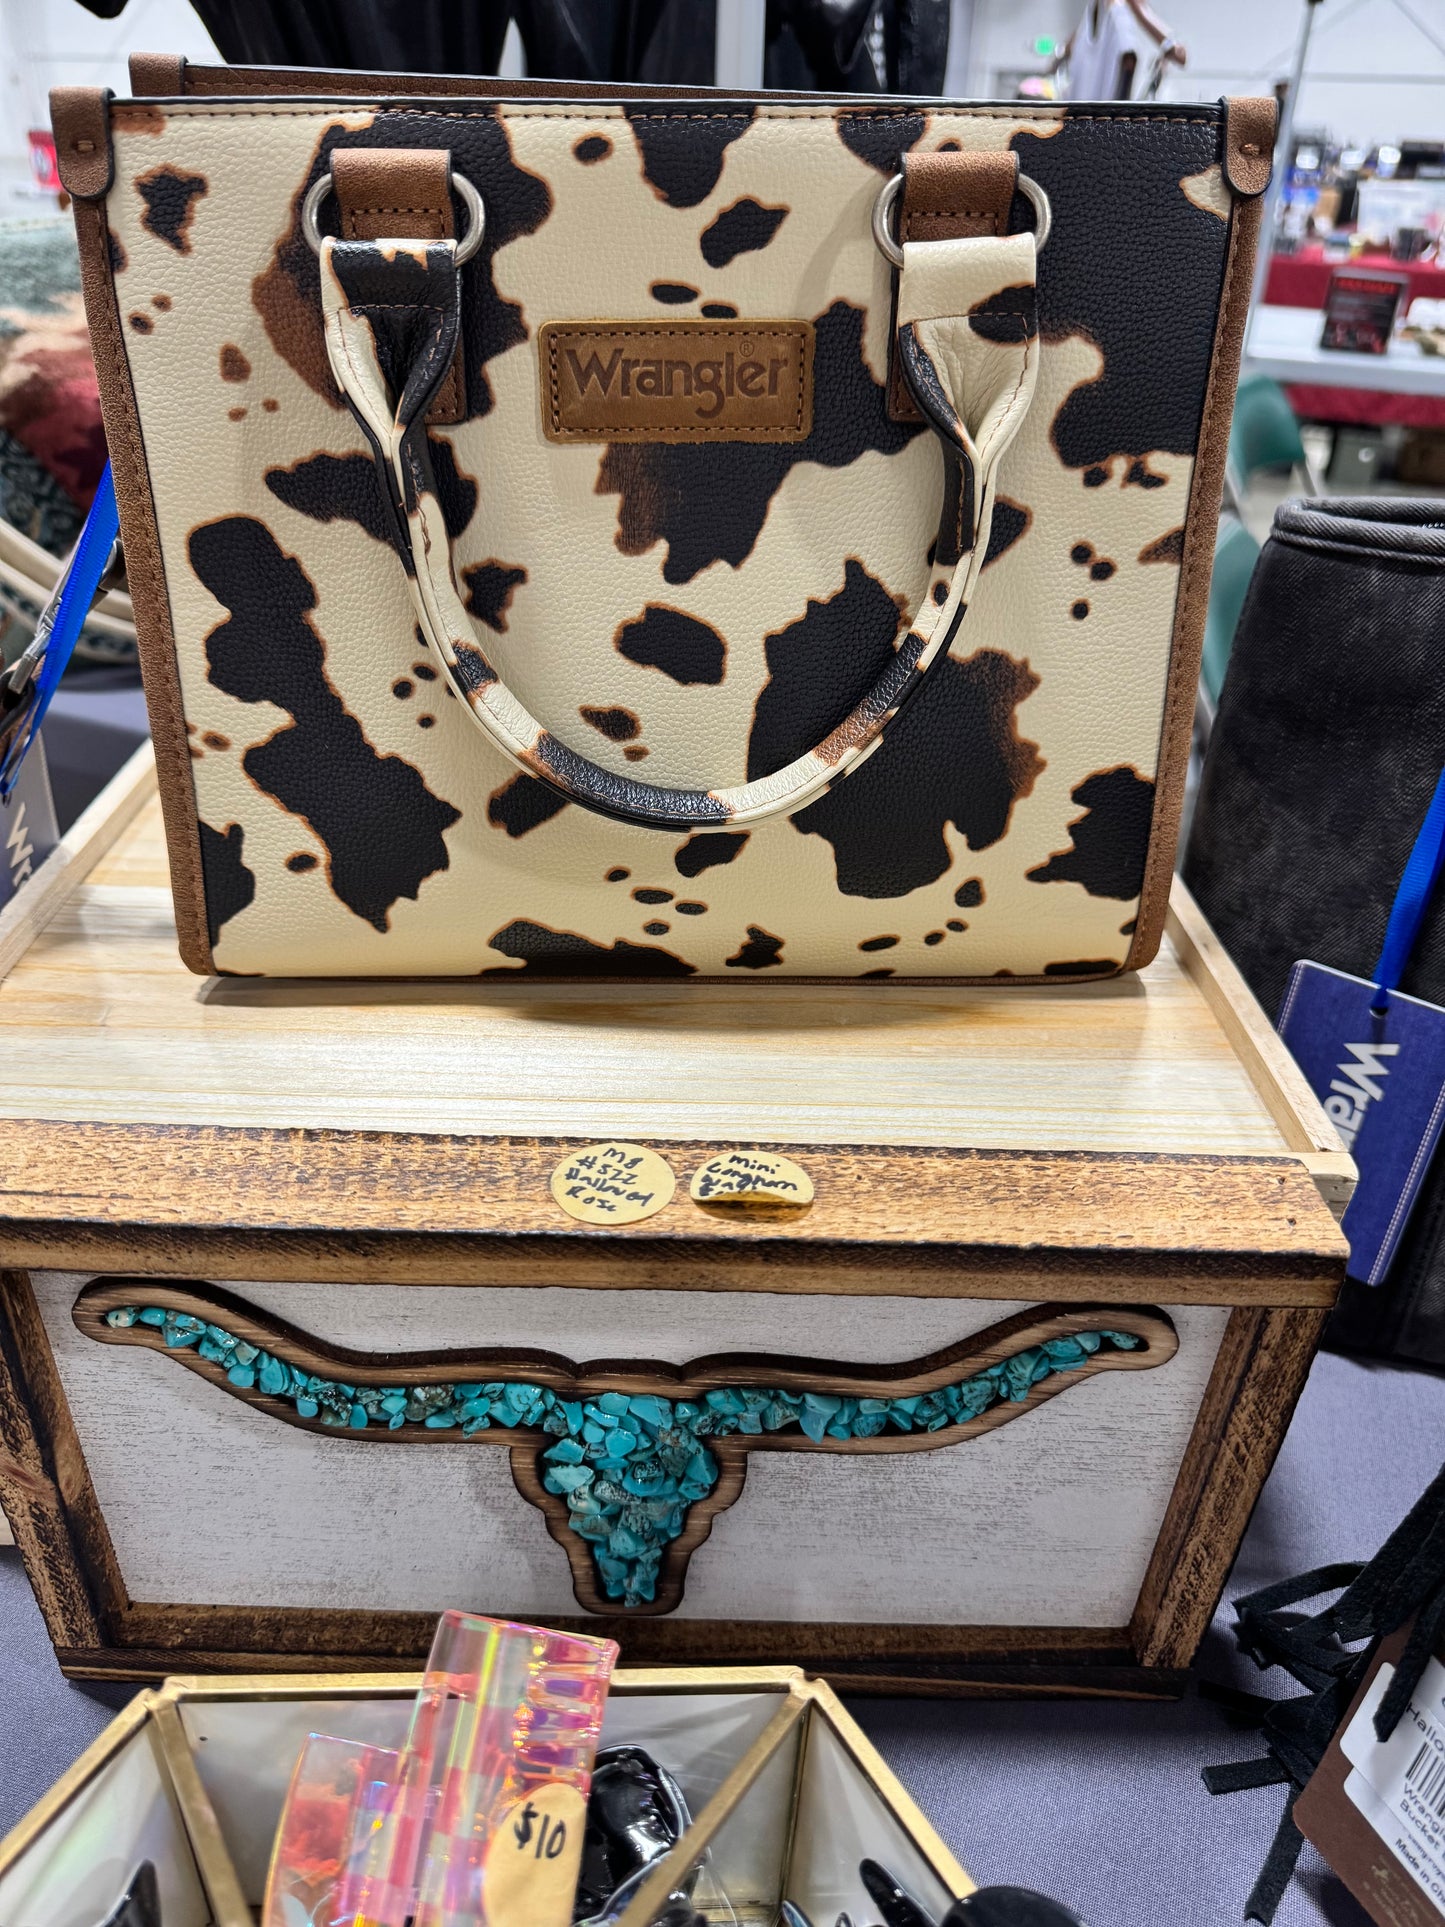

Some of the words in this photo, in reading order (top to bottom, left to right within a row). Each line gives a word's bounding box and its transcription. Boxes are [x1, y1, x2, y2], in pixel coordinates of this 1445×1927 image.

[565, 348, 788, 419] Wrangler
[1406, 1702, 1445, 1756] Hallo
[514, 1801, 567, 1859] $10
[1400, 1798, 1441, 1851] Bucket
[1395, 1838, 1420, 1870] Made
